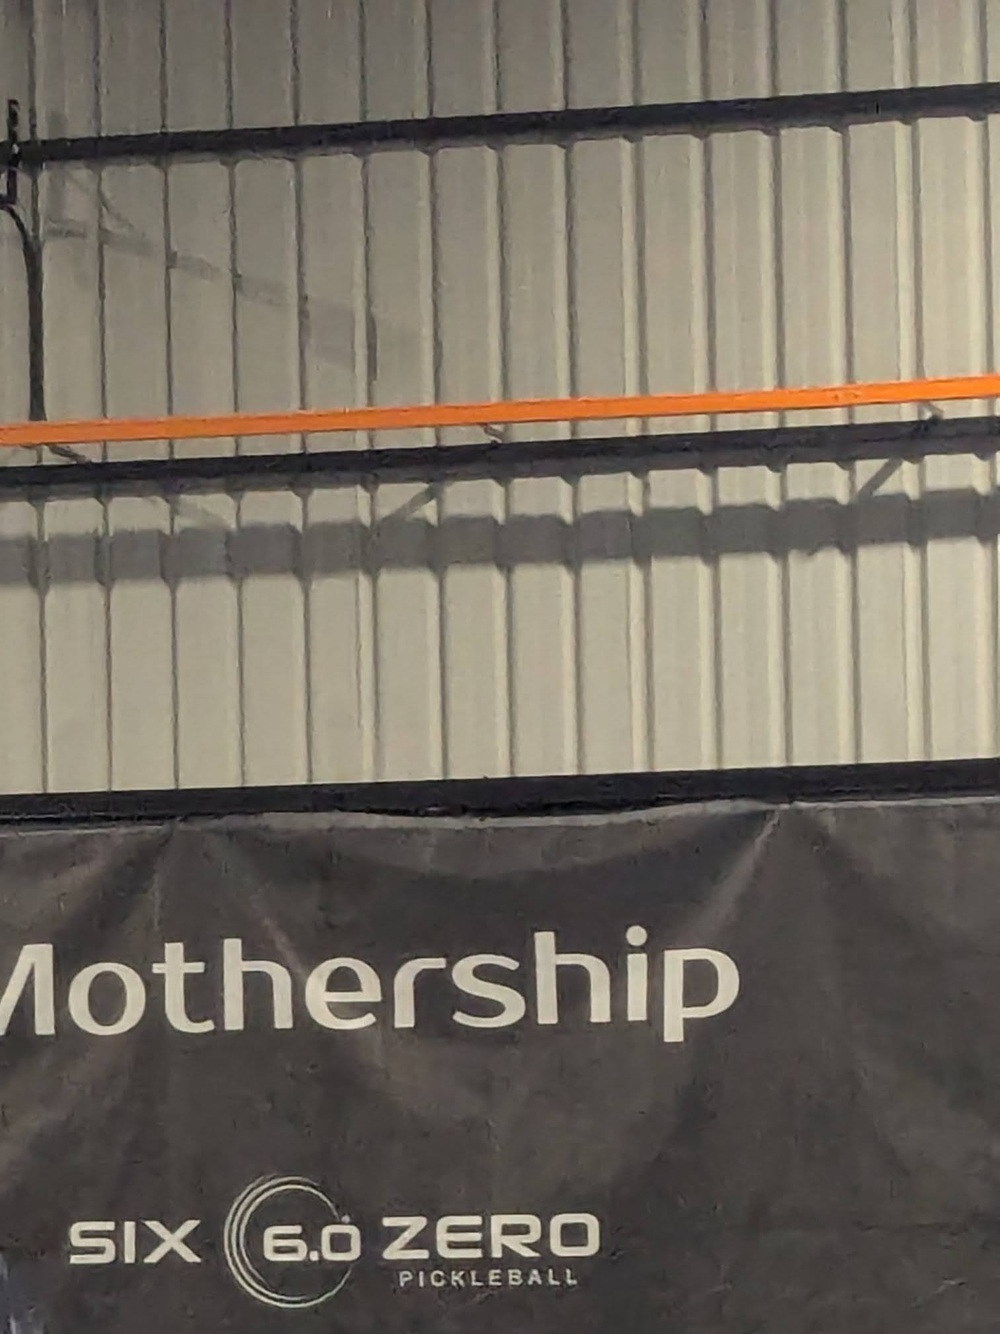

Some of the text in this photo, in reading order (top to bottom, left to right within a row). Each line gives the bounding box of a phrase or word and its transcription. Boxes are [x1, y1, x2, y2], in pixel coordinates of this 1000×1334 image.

[69, 1219, 202, 1265] SIX
[381, 1212, 601, 1260] ZERO
[399, 1268, 579, 1288] PICKLEBALL
